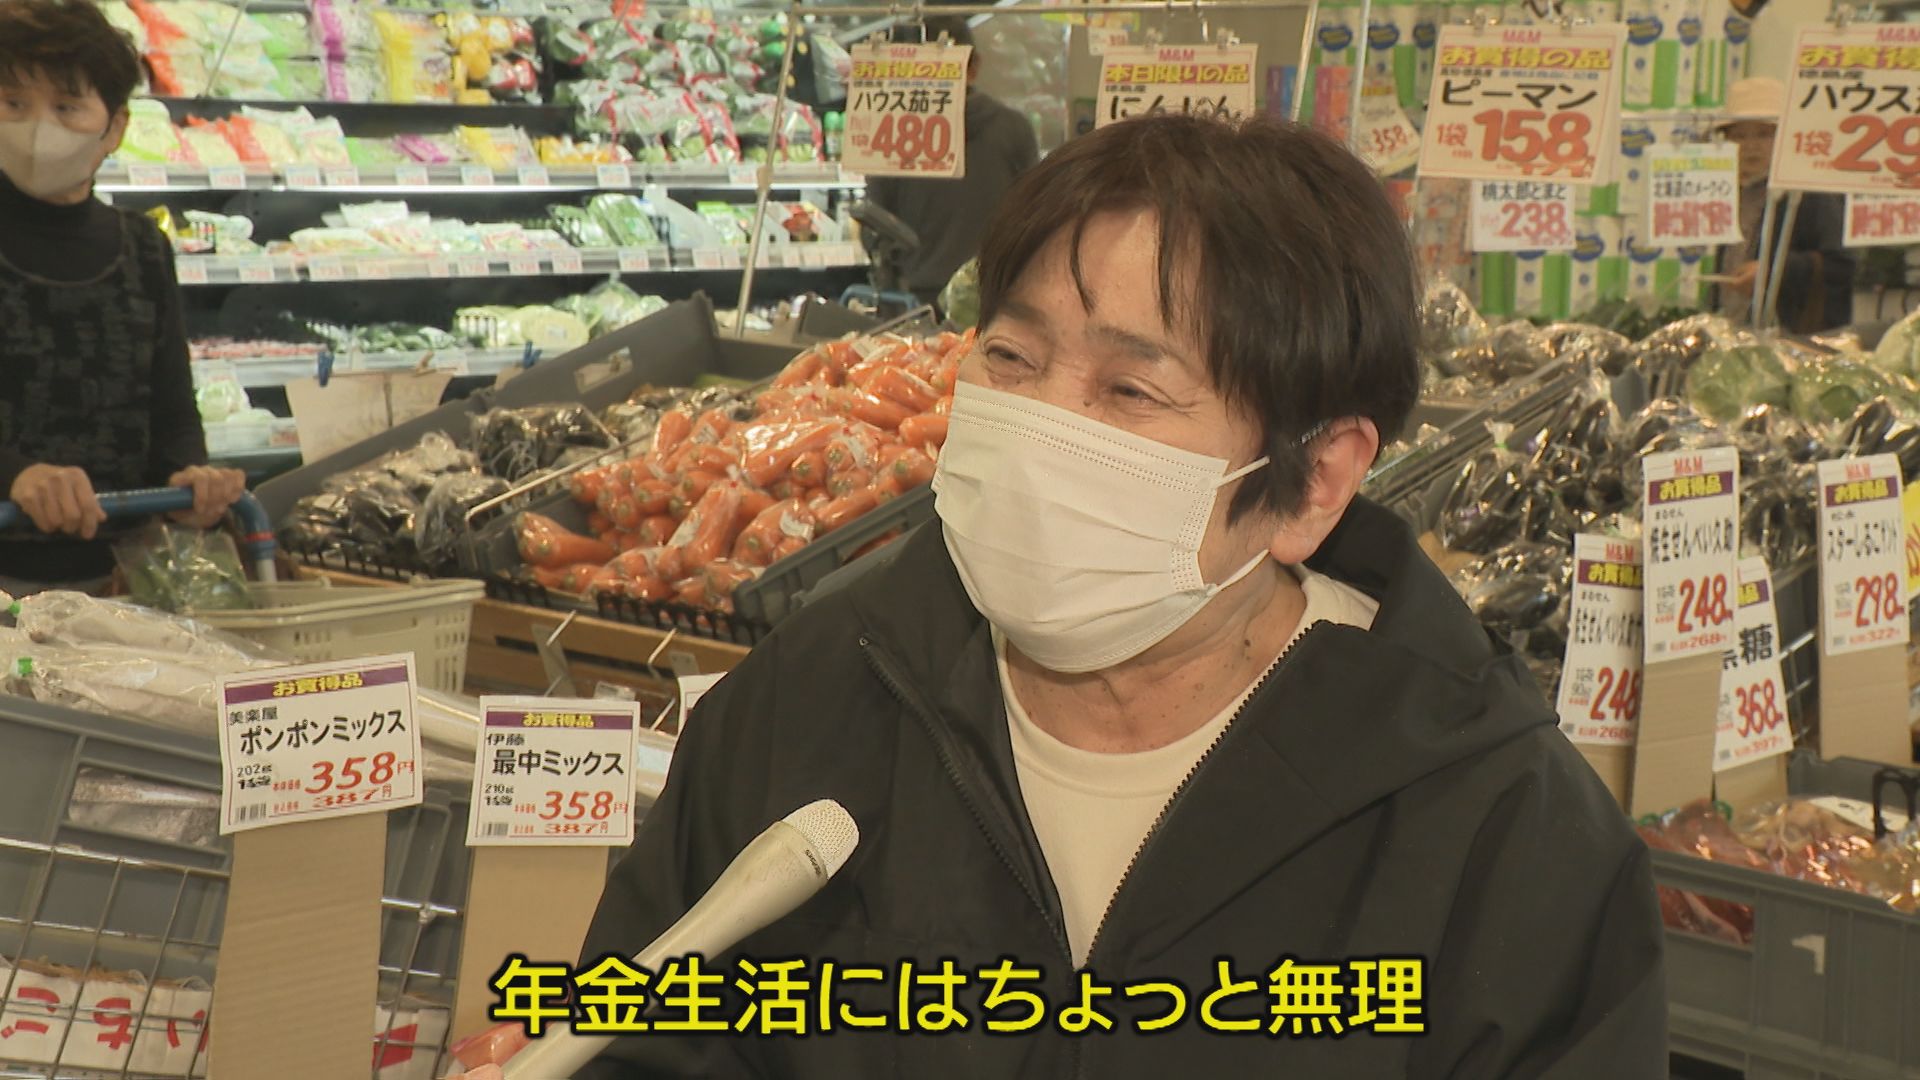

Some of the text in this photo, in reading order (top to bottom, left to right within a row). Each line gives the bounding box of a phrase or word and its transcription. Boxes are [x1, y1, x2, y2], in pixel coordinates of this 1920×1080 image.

[1106, 64, 1249, 83] 本日限りの品
[854, 90, 952, 113] ハウス茄子
[1442, 78, 1598, 109] ピーマン
[1800, 83, 1920, 114] ハウス
[273, 672, 363, 697] お買得品
[240, 709, 406, 755] ポンポンミックス
[523, 713, 594, 728] お買得品
[487, 733, 525, 746] 伊藤
[492, 749, 624, 776] 最中ミックス
